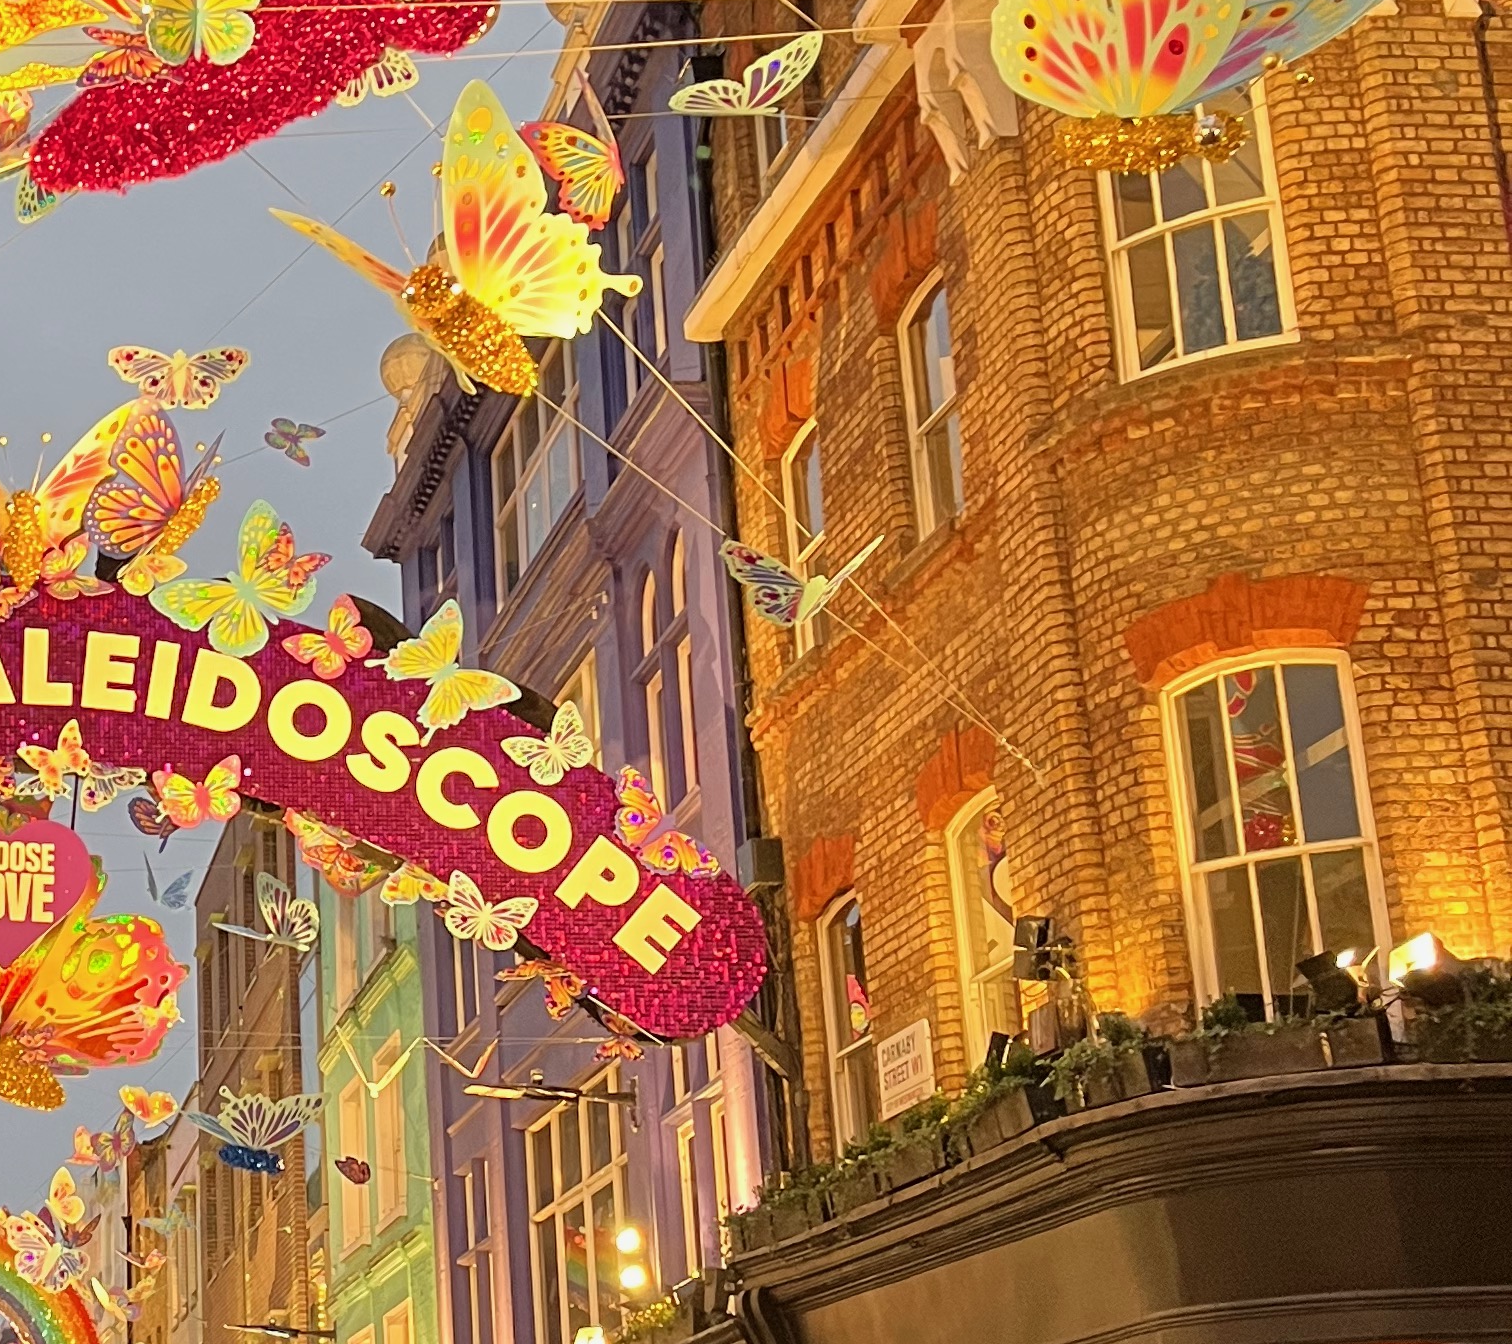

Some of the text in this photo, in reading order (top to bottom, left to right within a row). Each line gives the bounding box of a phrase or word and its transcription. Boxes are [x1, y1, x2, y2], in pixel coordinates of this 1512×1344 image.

[882, 1031, 916, 1067] CARNABY
[884, 1054, 923, 1091] STREET W1
